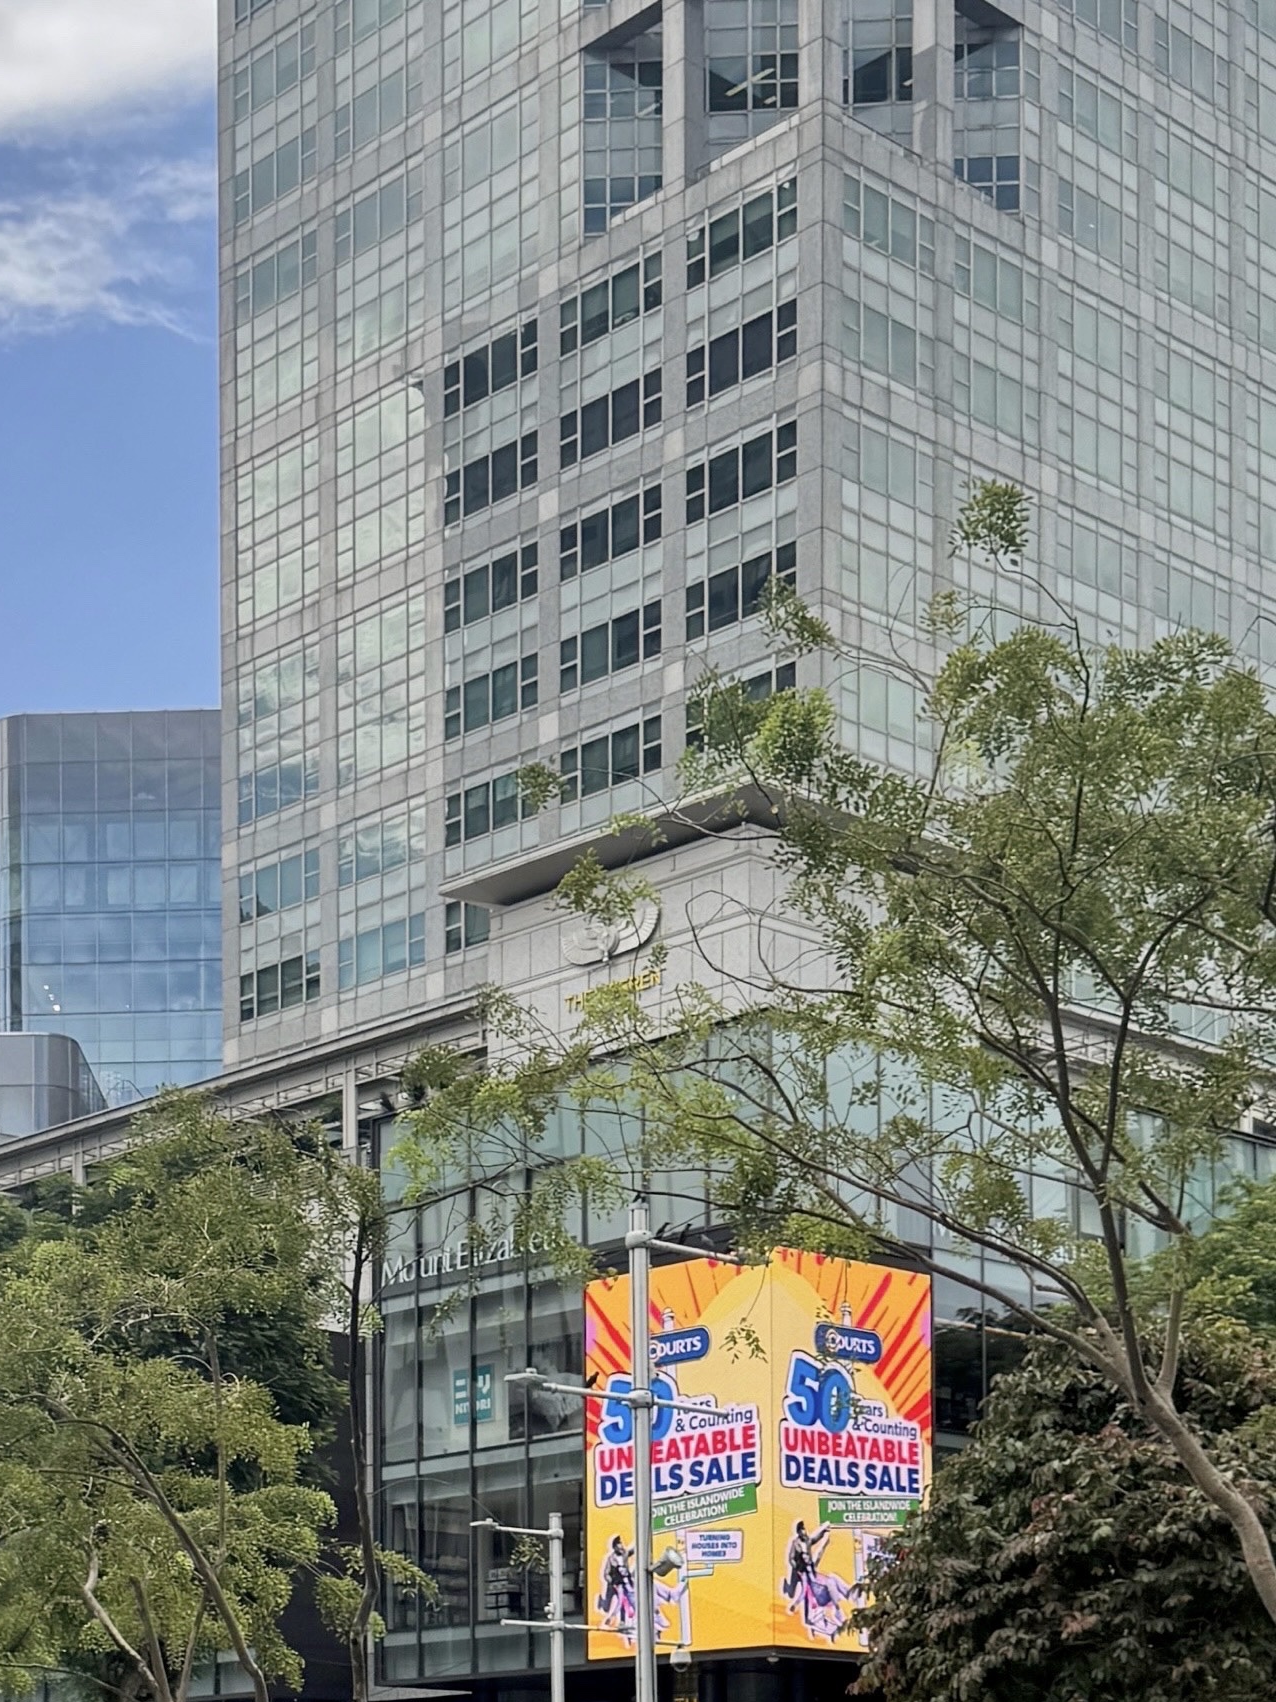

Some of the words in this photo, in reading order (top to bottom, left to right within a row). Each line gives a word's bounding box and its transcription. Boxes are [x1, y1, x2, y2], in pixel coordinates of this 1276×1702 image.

[565, 989, 594, 1015] TH
[381, 1248, 453, 1288] Mount
[456, 1222, 566, 1270] Elizabe
[649, 1335, 702, 1361] COURTS
[825, 1329, 875, 1355] COURTS
[455, 1374, 491, 1399] ニリ
[788, 1357, 852, 1434] 50
[603, 1378, 674, 1445] 50
[675, 1418, 686, 1433] &
[863, 1417, 918, 1441] Counting
[599, 1425, 757, 1473] UNEATABLE
[784, 1427, 920, 1466] UNBEATABLE
[600, 1463, 684, 1501] DELS
[689, 1451, 757, 1488] SALE
[785, 1454, 860, 1488] DEALS
[865, 1463, 920, 1494] SALE
[651, 1505, 667, 1518] OIN
[668, 1501, 687, 1513] THE
[687, 1487, 745, 1510] ISLANDWIDE
[664, 1504, 728, 1527] CELEBRATION!
[828, 1500, 846, 1512] JOIN
[847, 1500, 862, 1511] THE
[862, 1500, 911, 1511] ISLANDWIDE
[843, 1512, 898, 1523] CELEBRATION!
